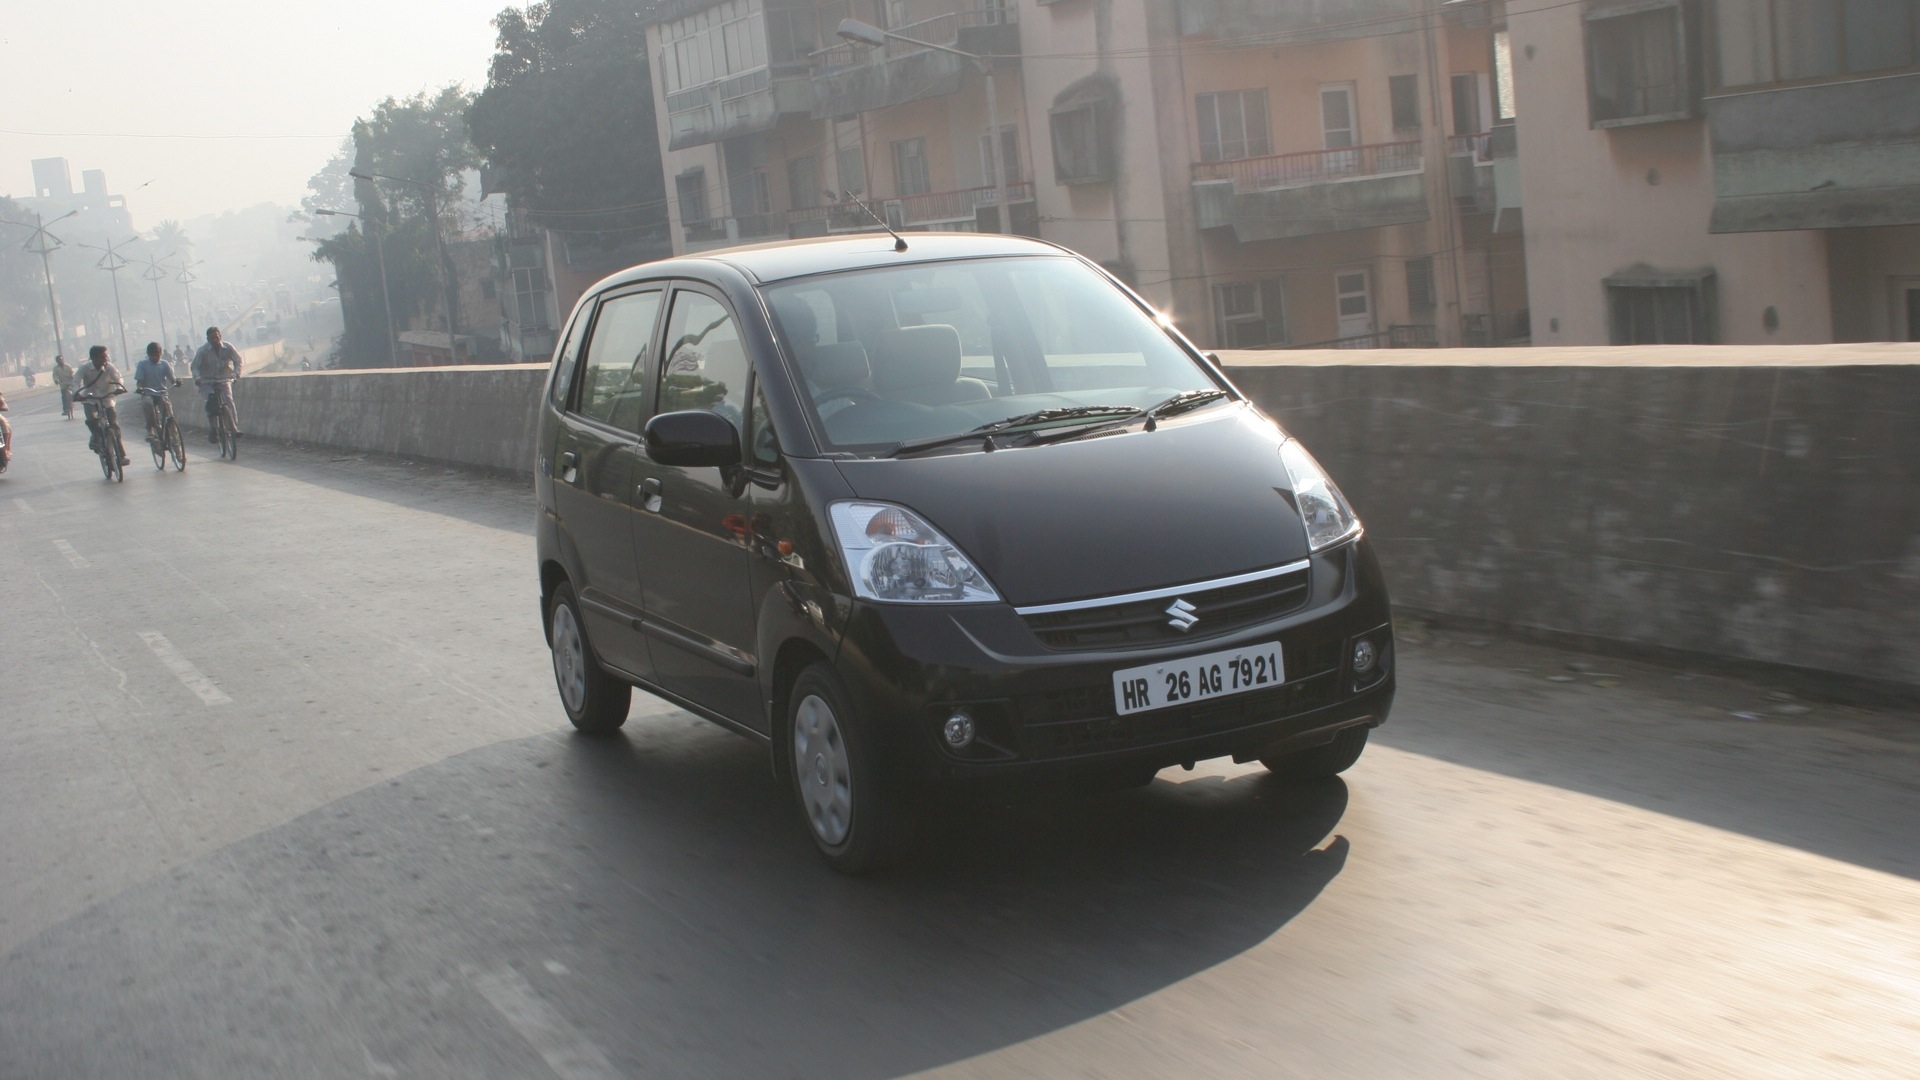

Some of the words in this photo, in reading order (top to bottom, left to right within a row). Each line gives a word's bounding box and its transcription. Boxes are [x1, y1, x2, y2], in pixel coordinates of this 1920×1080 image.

[1122, 678, 1151, 710] HR
[1165, 670, 1191, 702] 26
[1199, 664, 1223, 696] AG
[1228, 653, 1277, 689] 7921
